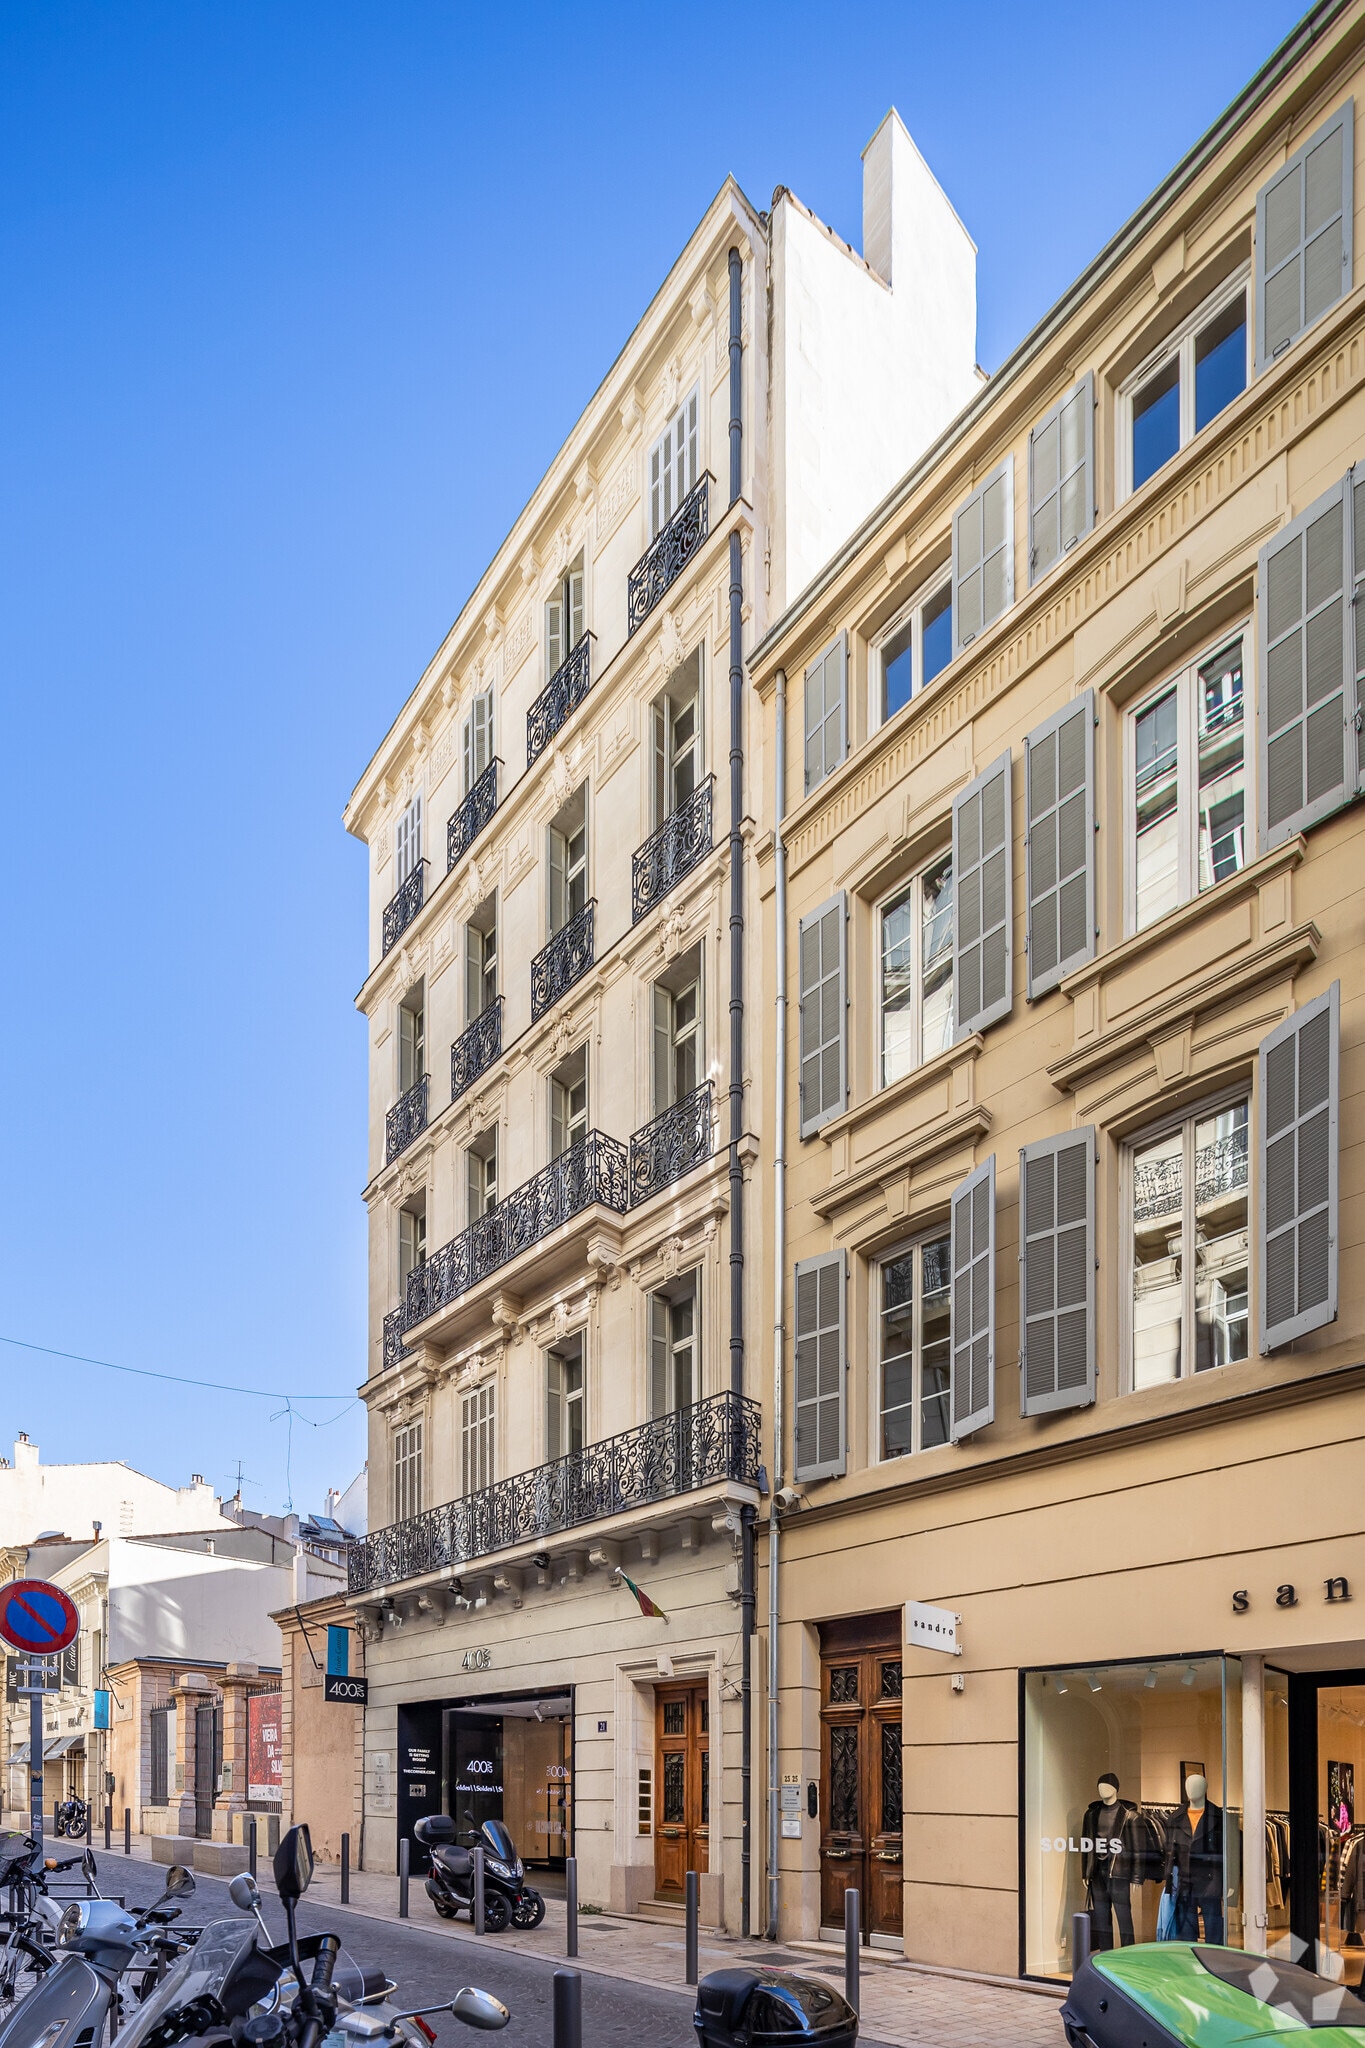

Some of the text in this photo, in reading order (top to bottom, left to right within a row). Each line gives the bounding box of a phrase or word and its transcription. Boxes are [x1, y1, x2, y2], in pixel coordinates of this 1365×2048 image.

[914, 1620, 953, 1636] sandro
[9, 1671, 17, 1687] IWC
[1040, 1837, 1123, 1854] SOLDES
